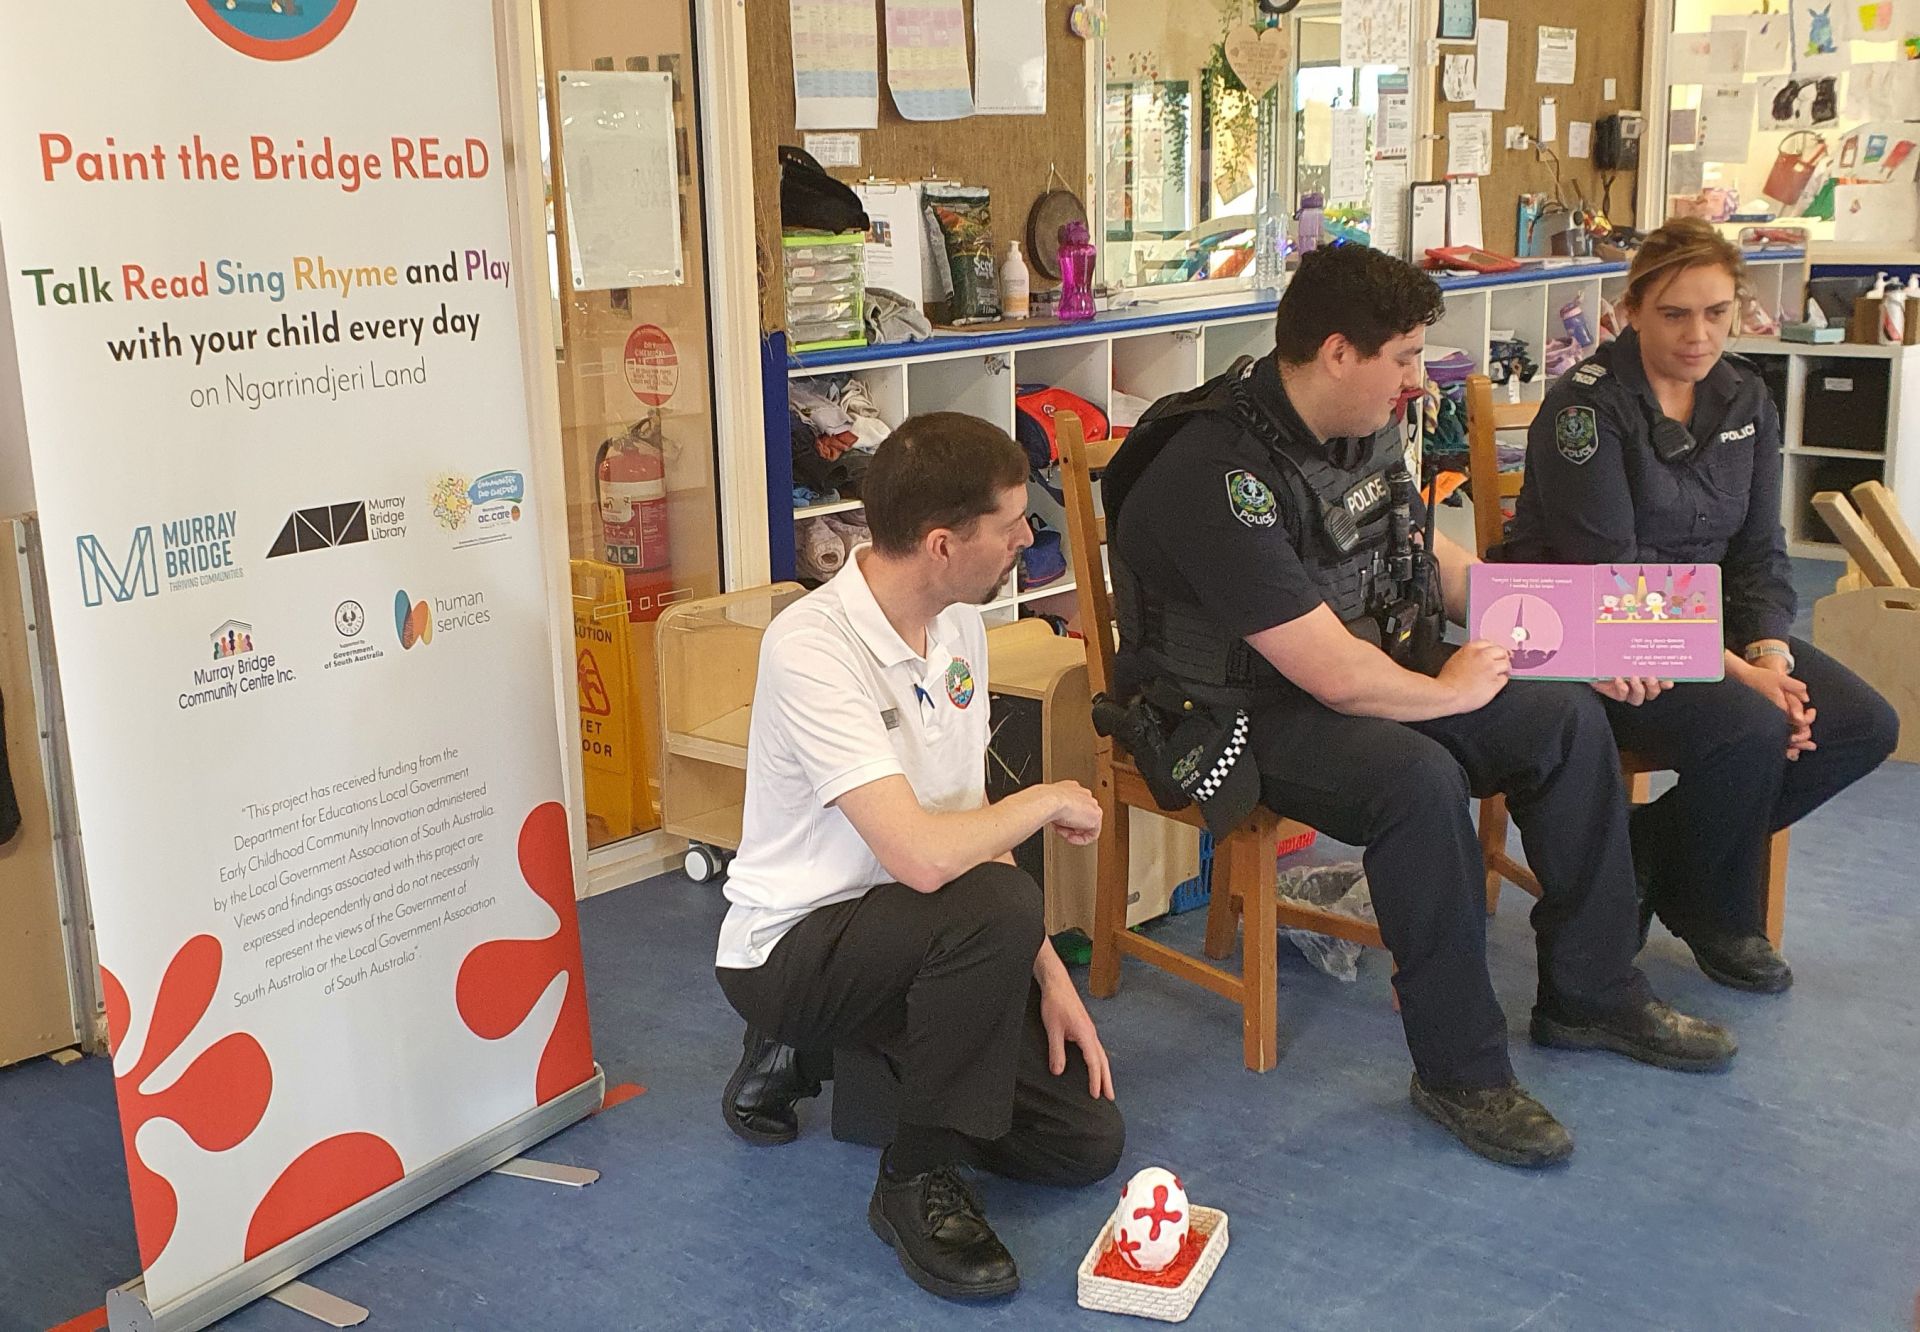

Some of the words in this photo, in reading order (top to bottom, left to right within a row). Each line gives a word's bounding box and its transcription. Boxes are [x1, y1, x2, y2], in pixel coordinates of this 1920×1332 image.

[39, 133, 166, 182] Paint
[177, 134, 240, 181] the
[250, 136, 382, 192] Bridge
[391, 136, 489, 180] REaD
[21, 266, 114, 306] Talk
[122, 261, 209, 301] Read
[216, 259, 285, 302] Sing
[293, 256, 398, 298] Rhyme
[406, 251, 458, 284] and
[465, 249, 510, 289] Play
[107, 322, 182, 362] with
[190, 329, 257, 366] your
[266, 310, 340, 348] child
[350, 317, 424, 346] every
[433, 302, 480, 341] day
[190, 387, 219, 408] on
[226, 364, 365, 410] Ngarrindjeri
[370, 355, 427, 389] Land
[369, 496, 406, 511] Murray
[1347, 477, 1387, 515] POLICE
[162, 510, 237, 550] MURRAY
[370, 511, 405, 525] Bridge
[371, 526, 407, 540] Library
[1238, 509, 1275, 526] POLICE
[165, 539, 234, 578] BRIDGE
[169, 576, 199, 593] THRIVING
[200, 567, 244, 586] COMMUNITIES
[435, 592, 484, 613] human
[437, 609, 491, 633] services
[333, 645, 374, 660] Government
[575, 625, 613, 644] UTION
[194, 665, 235, 686] Murray
[238, 655, 275, 675] Bridge
[324, 662, 332, 670] of
[333, 658, 353, 668] South
[354, 650, 384, 662] Australia
[178, 682, 237, 710] Community
[240, 673, 275, 692] Centre
[276, 669, 297, 684] Inc.
[582, 738, 613, 758] OOR
[272, 792, 308, 817] project
[310, 786, 331, 800] has
[332, 768, 376, 793] received
[378, 761, 418, 780] funding
[419, 753, 442, 768] from
[443, 747, 459, 761] the
[234, 820, 300, 851] Department
[301, 813, 317, 829] for
[318, 797, 378, 823] Educations
[380, 783, 409, 804] Local
[410, 767, 469, 794] Government
[219, 862, 247, 883] Early
[248, 840, 305, 872] Childhood
[306, 823, 369, 851] Community
[370, 805, 425, 831] Innovation
[427, 781, 487, 813] administered
[213, 897, 228, 913] by
[230, 890, 247, 905] the
[249, 875, 278, 899] Local
[279, 853, 346, 886] Government
[348, 835, 409, 863] Association
[410, 825, 421, 843] of
[422, 818, 451, 839] South
[452, 804, 495, 828] Australia
[233, 909, 266, 929] Views
[267, 896, 289, 917] and
[290, 885, 333, 909] findings
[335, 860, 391, 892] associated
[393, 854, 415, 872] with
[416, 849, 433, 864] this
[434, 838, 466, 861] project
[467, 833, 484, 846] are
[243, 920, 295, 953] expressed
[297, 893, 371, 930] independently
[373, 884, 394, 903] and
[396, 880, 411, 895] do
[412, 875, 429, 890] not
[430, 854, 480, 883] necessarily
[265, 941, 313, 970] represent
[316, 933, 333, 948] the
[334, 923, 363, 941] views
[364, 913, 375, 930] of
[377, 912, 394, 925] the
[395, 887, 456, 918] Government
[457, 880, 468, 896] of
[233, 984, 266, 1008] South
[267, 965, 315, 994] Australia
[316, 961, 328, 974] or
[330, 953, 347, 968] the
[348, 939, 378, 961] Local
[379, 917, 441, 948] Government
[443, 896, 496, 923] Association
[324, 978, 335, 996] of
[336, 967, 368, 990] South
